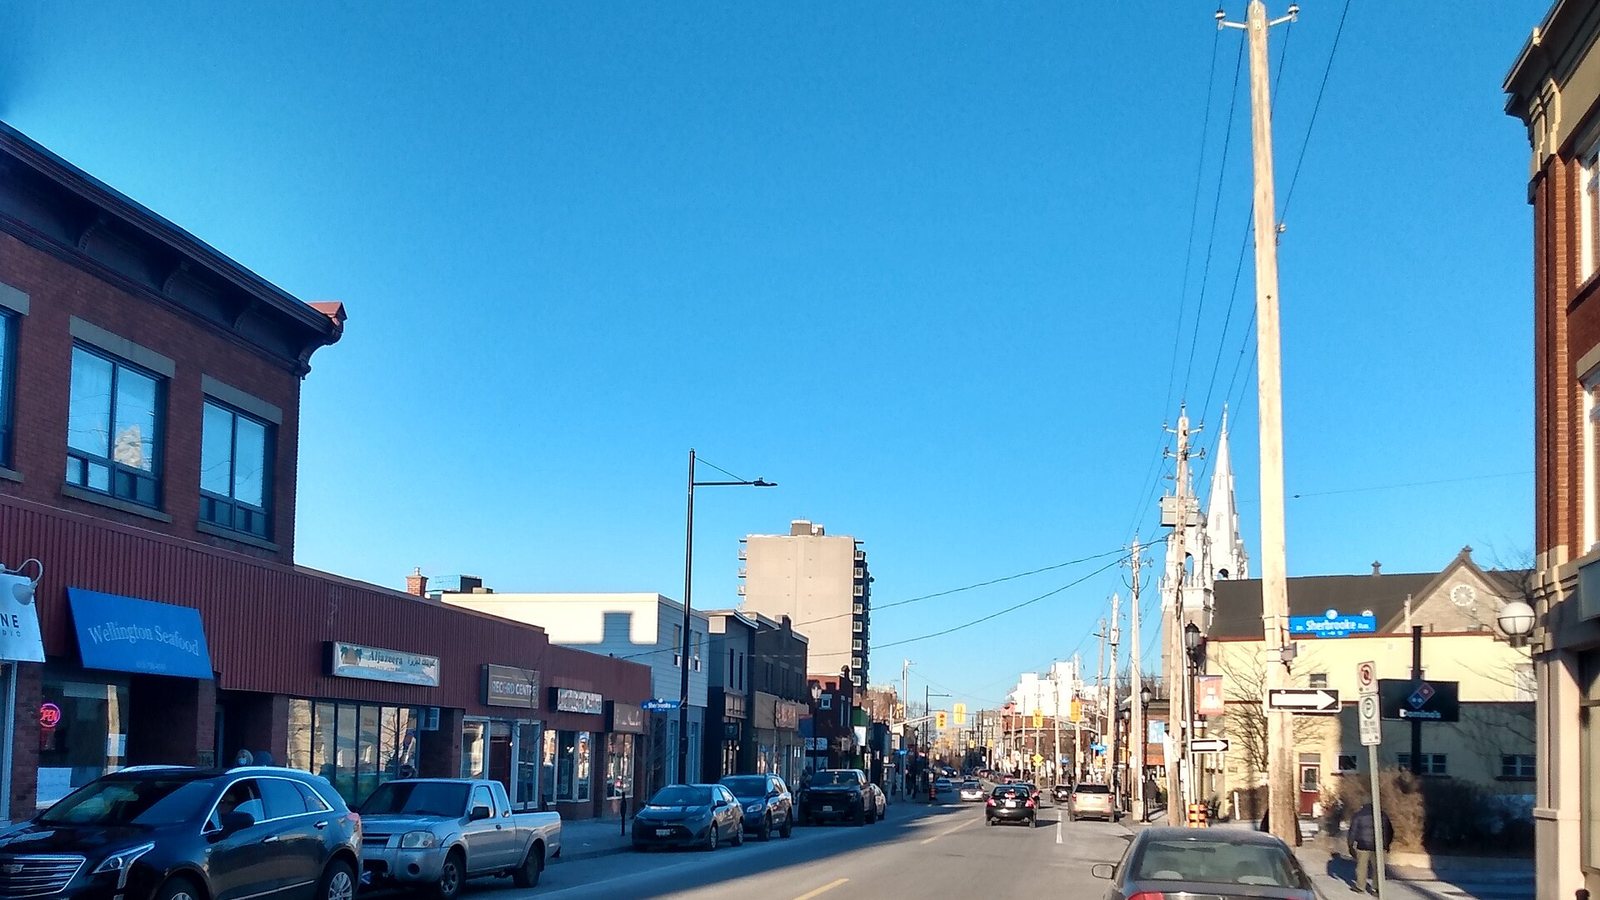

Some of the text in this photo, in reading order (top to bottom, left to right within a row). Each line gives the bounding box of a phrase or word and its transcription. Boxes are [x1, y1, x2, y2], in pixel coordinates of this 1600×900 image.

[1306, 619, 1356, 631] Sherbrooke
[88, 621, 200, 657] Wellington Seafood
[368, 650, 403, 666] Aljazeera
